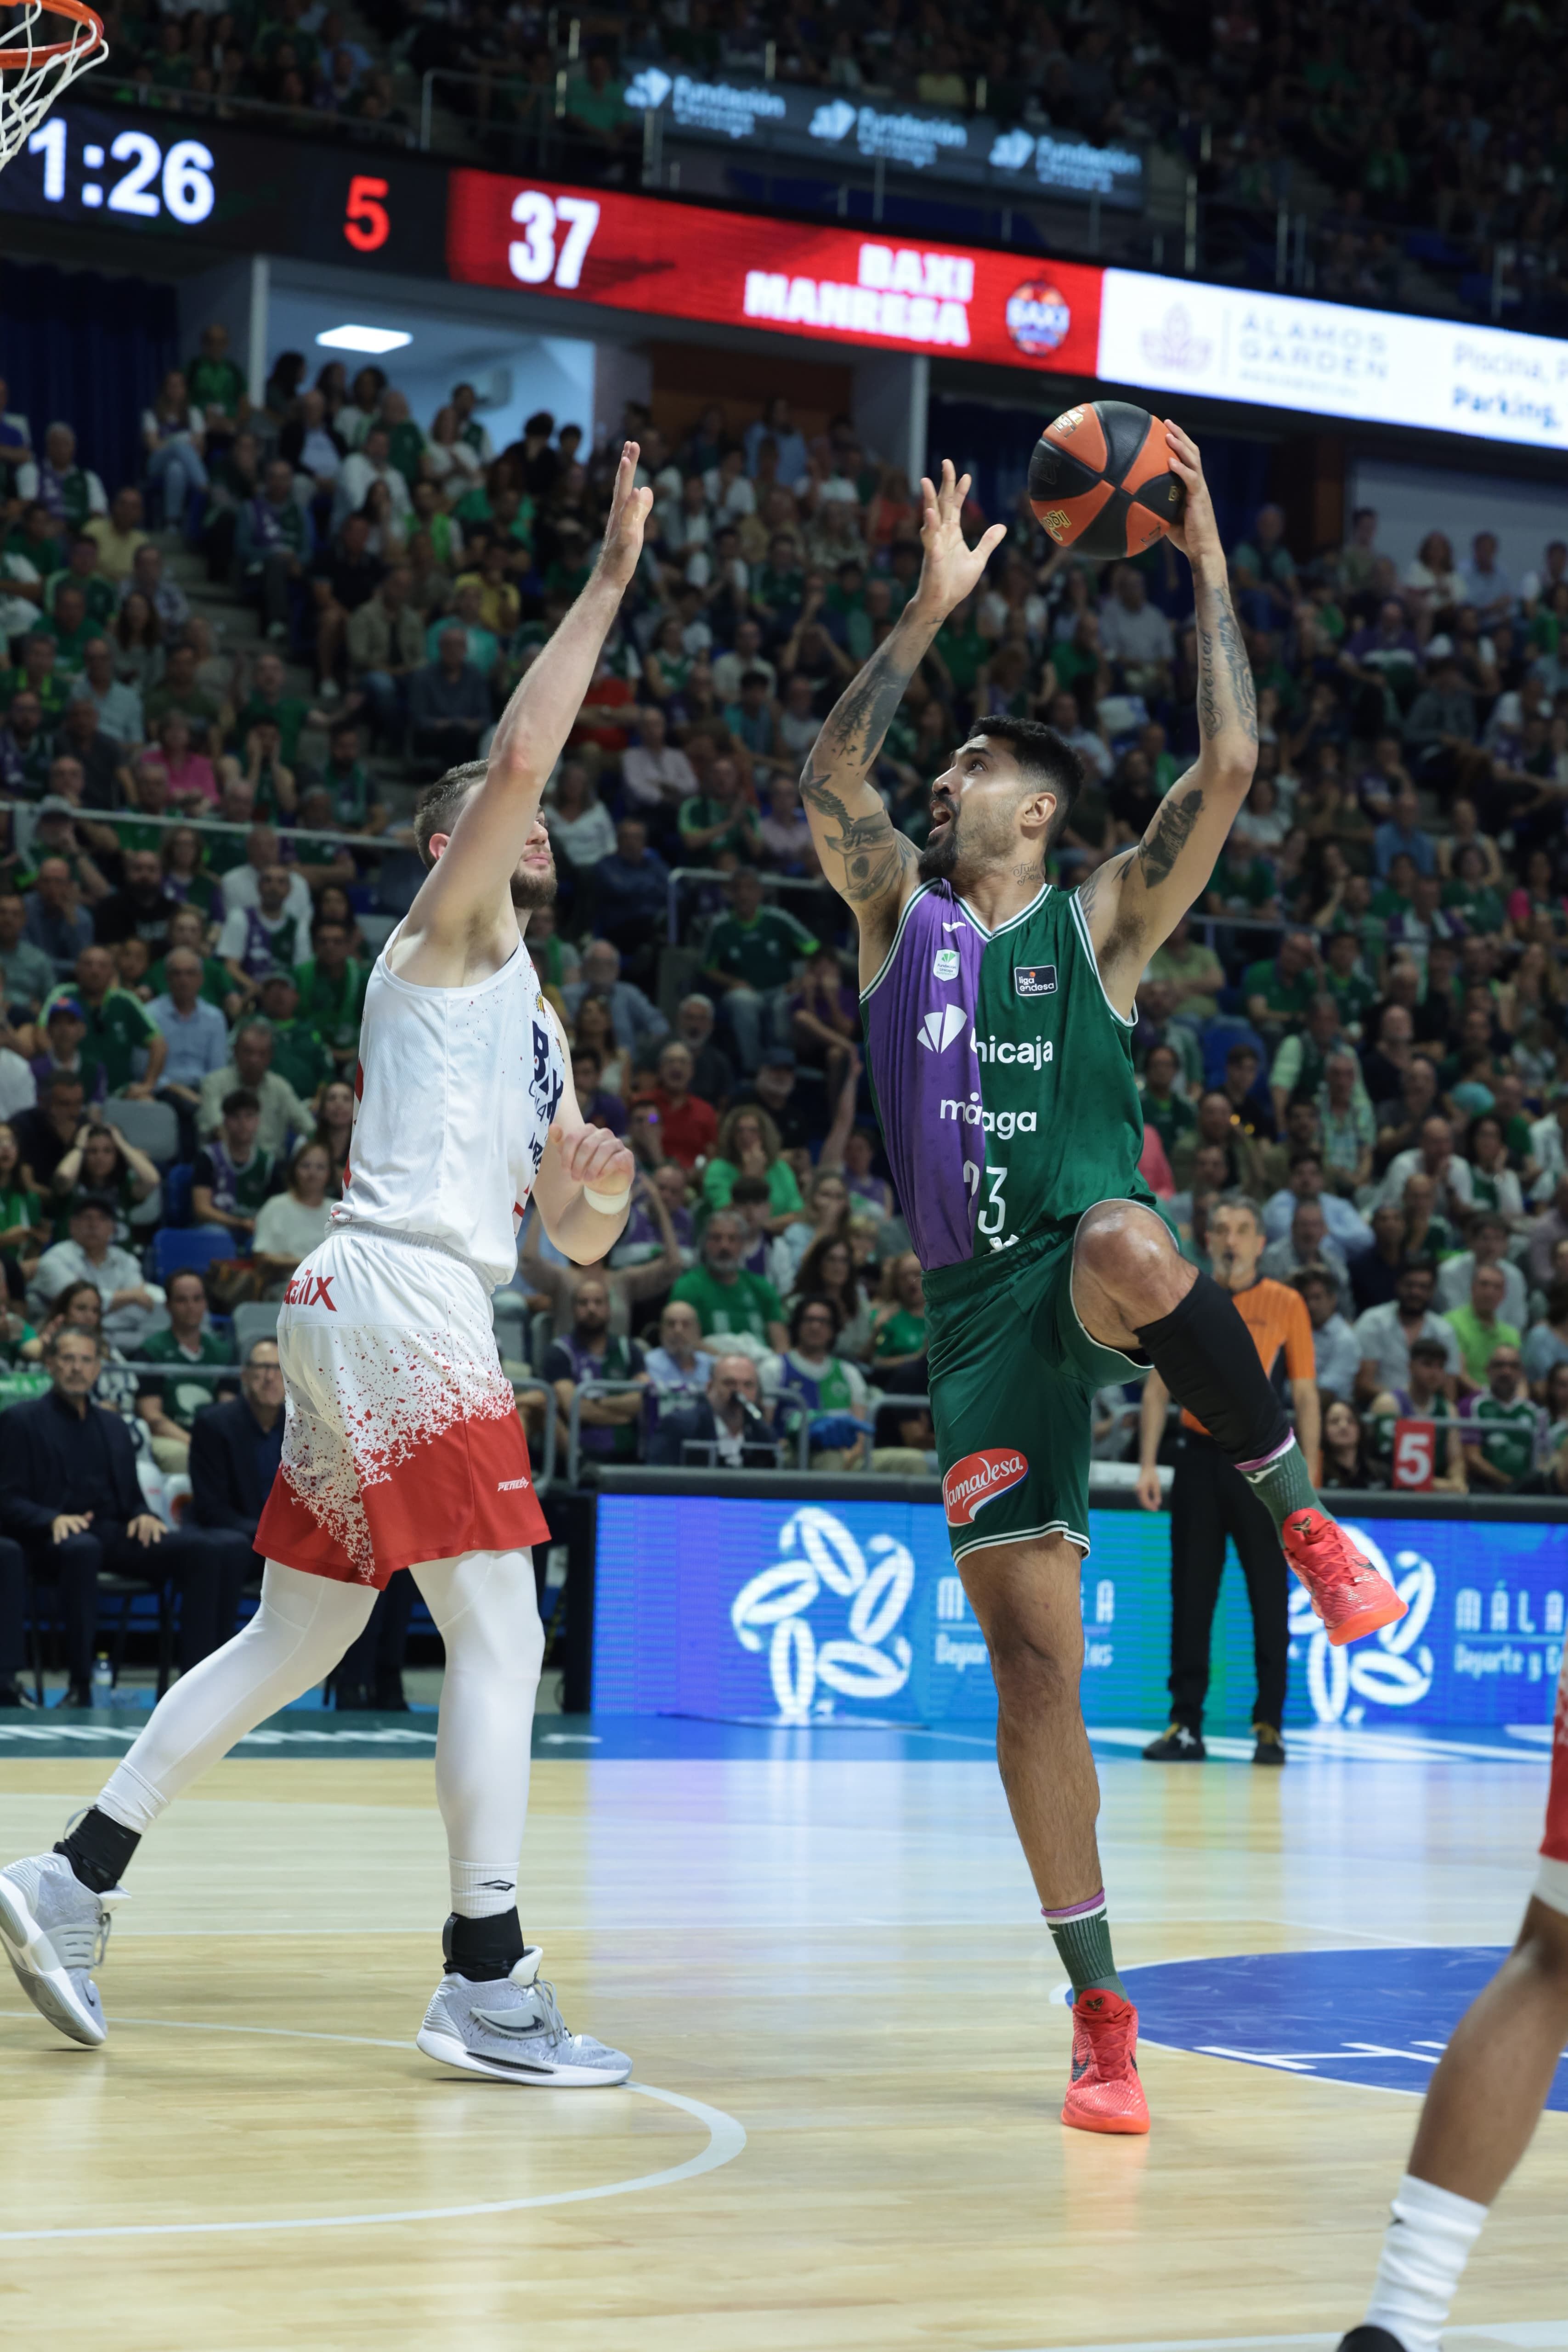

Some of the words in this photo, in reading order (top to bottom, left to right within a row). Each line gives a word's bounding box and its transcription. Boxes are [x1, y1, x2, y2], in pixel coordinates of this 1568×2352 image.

[28, 118, 215, 225] 1:26
[343, 175, 391, 252] 5
[509, 191, 600, 289] 37
[858, 243, 974, 303] BAXI
[743, 270, 970, 347] MANRESA
[1240, 339, 1388, 381] GARDEN
[1019, 976, 1034, 986] liga
[1019, 983, 1054, 992] endesa
[1396, 1433, 1432, 1485] 5
